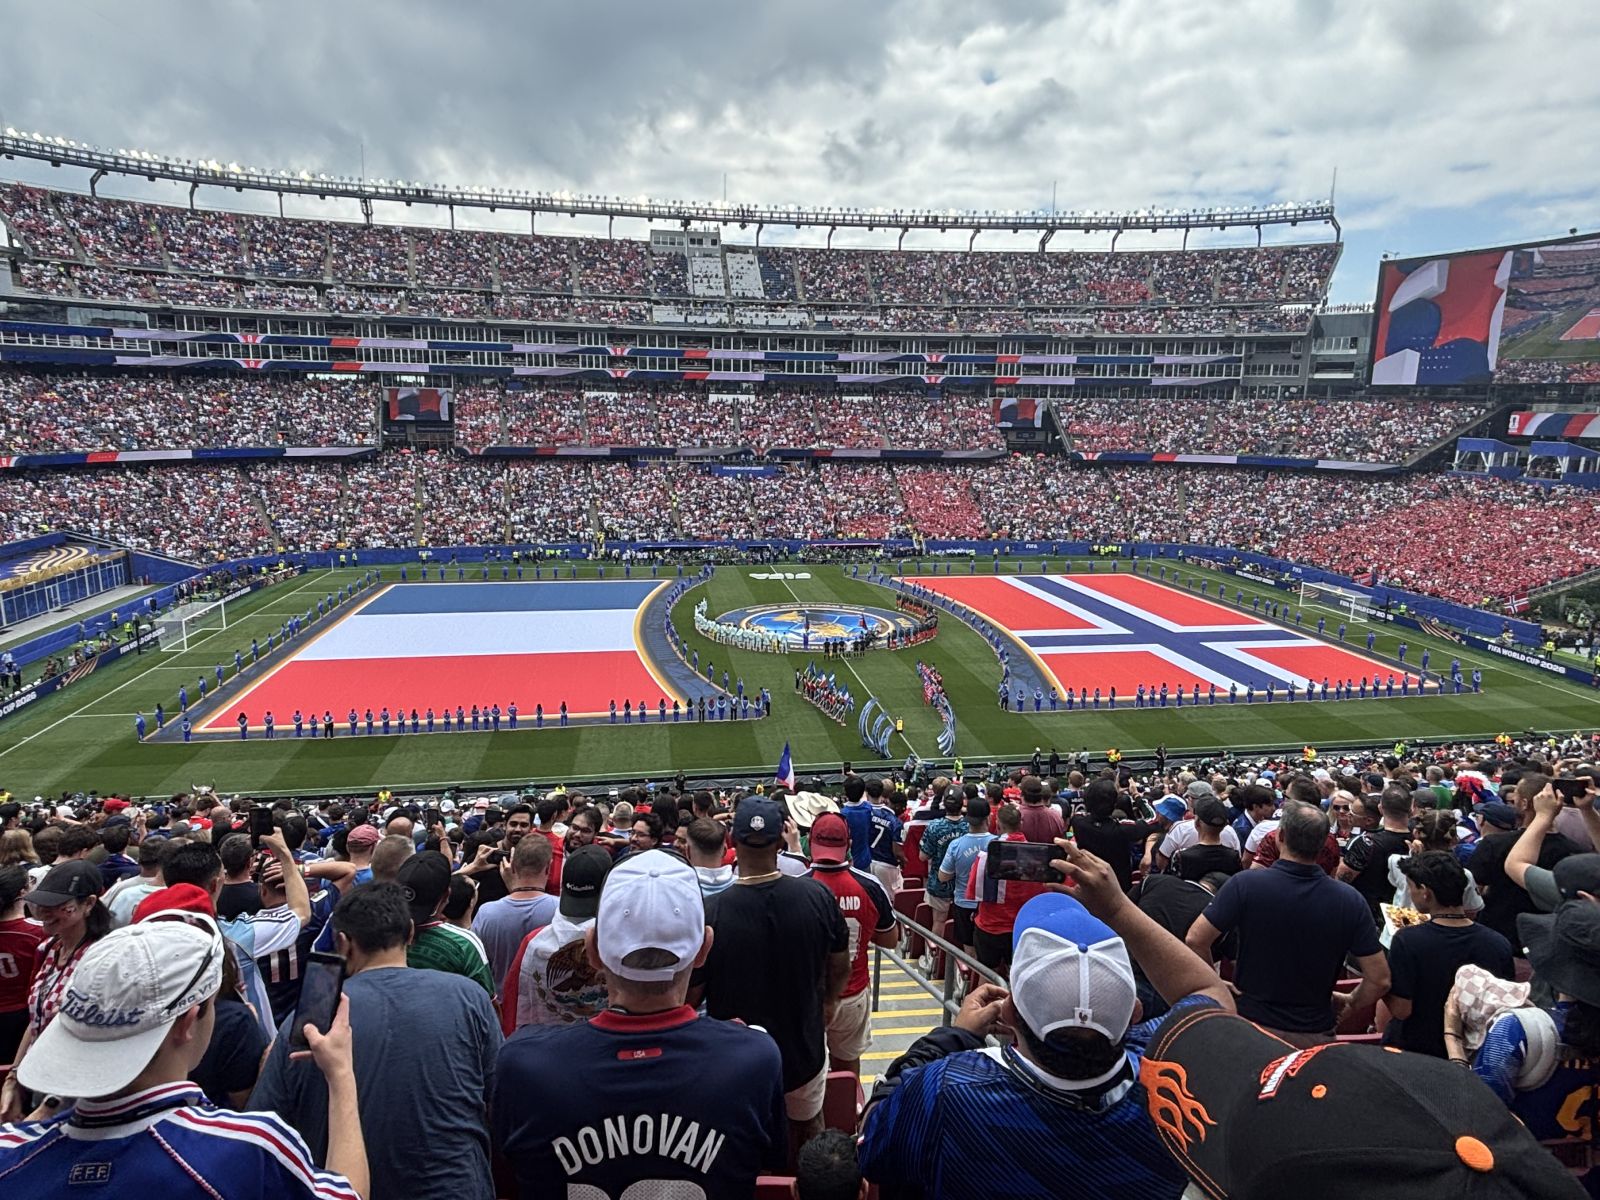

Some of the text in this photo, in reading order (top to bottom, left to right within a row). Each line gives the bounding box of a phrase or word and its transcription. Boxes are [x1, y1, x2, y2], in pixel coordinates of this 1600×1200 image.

[129, 637, 145, 649] WOLD
[1487, 644, 1566, 674] FIFA WORLD CUP 2026
[3, 702, 16, 715] CUP
[15, 691, 37, 708] 2026
[870, 824, 885, 849] 7
[835, 896, 861, 911] AND
[60, 987, 145, 1027] Titleist
[551, 1113, 726, 1176] DONOVAN
